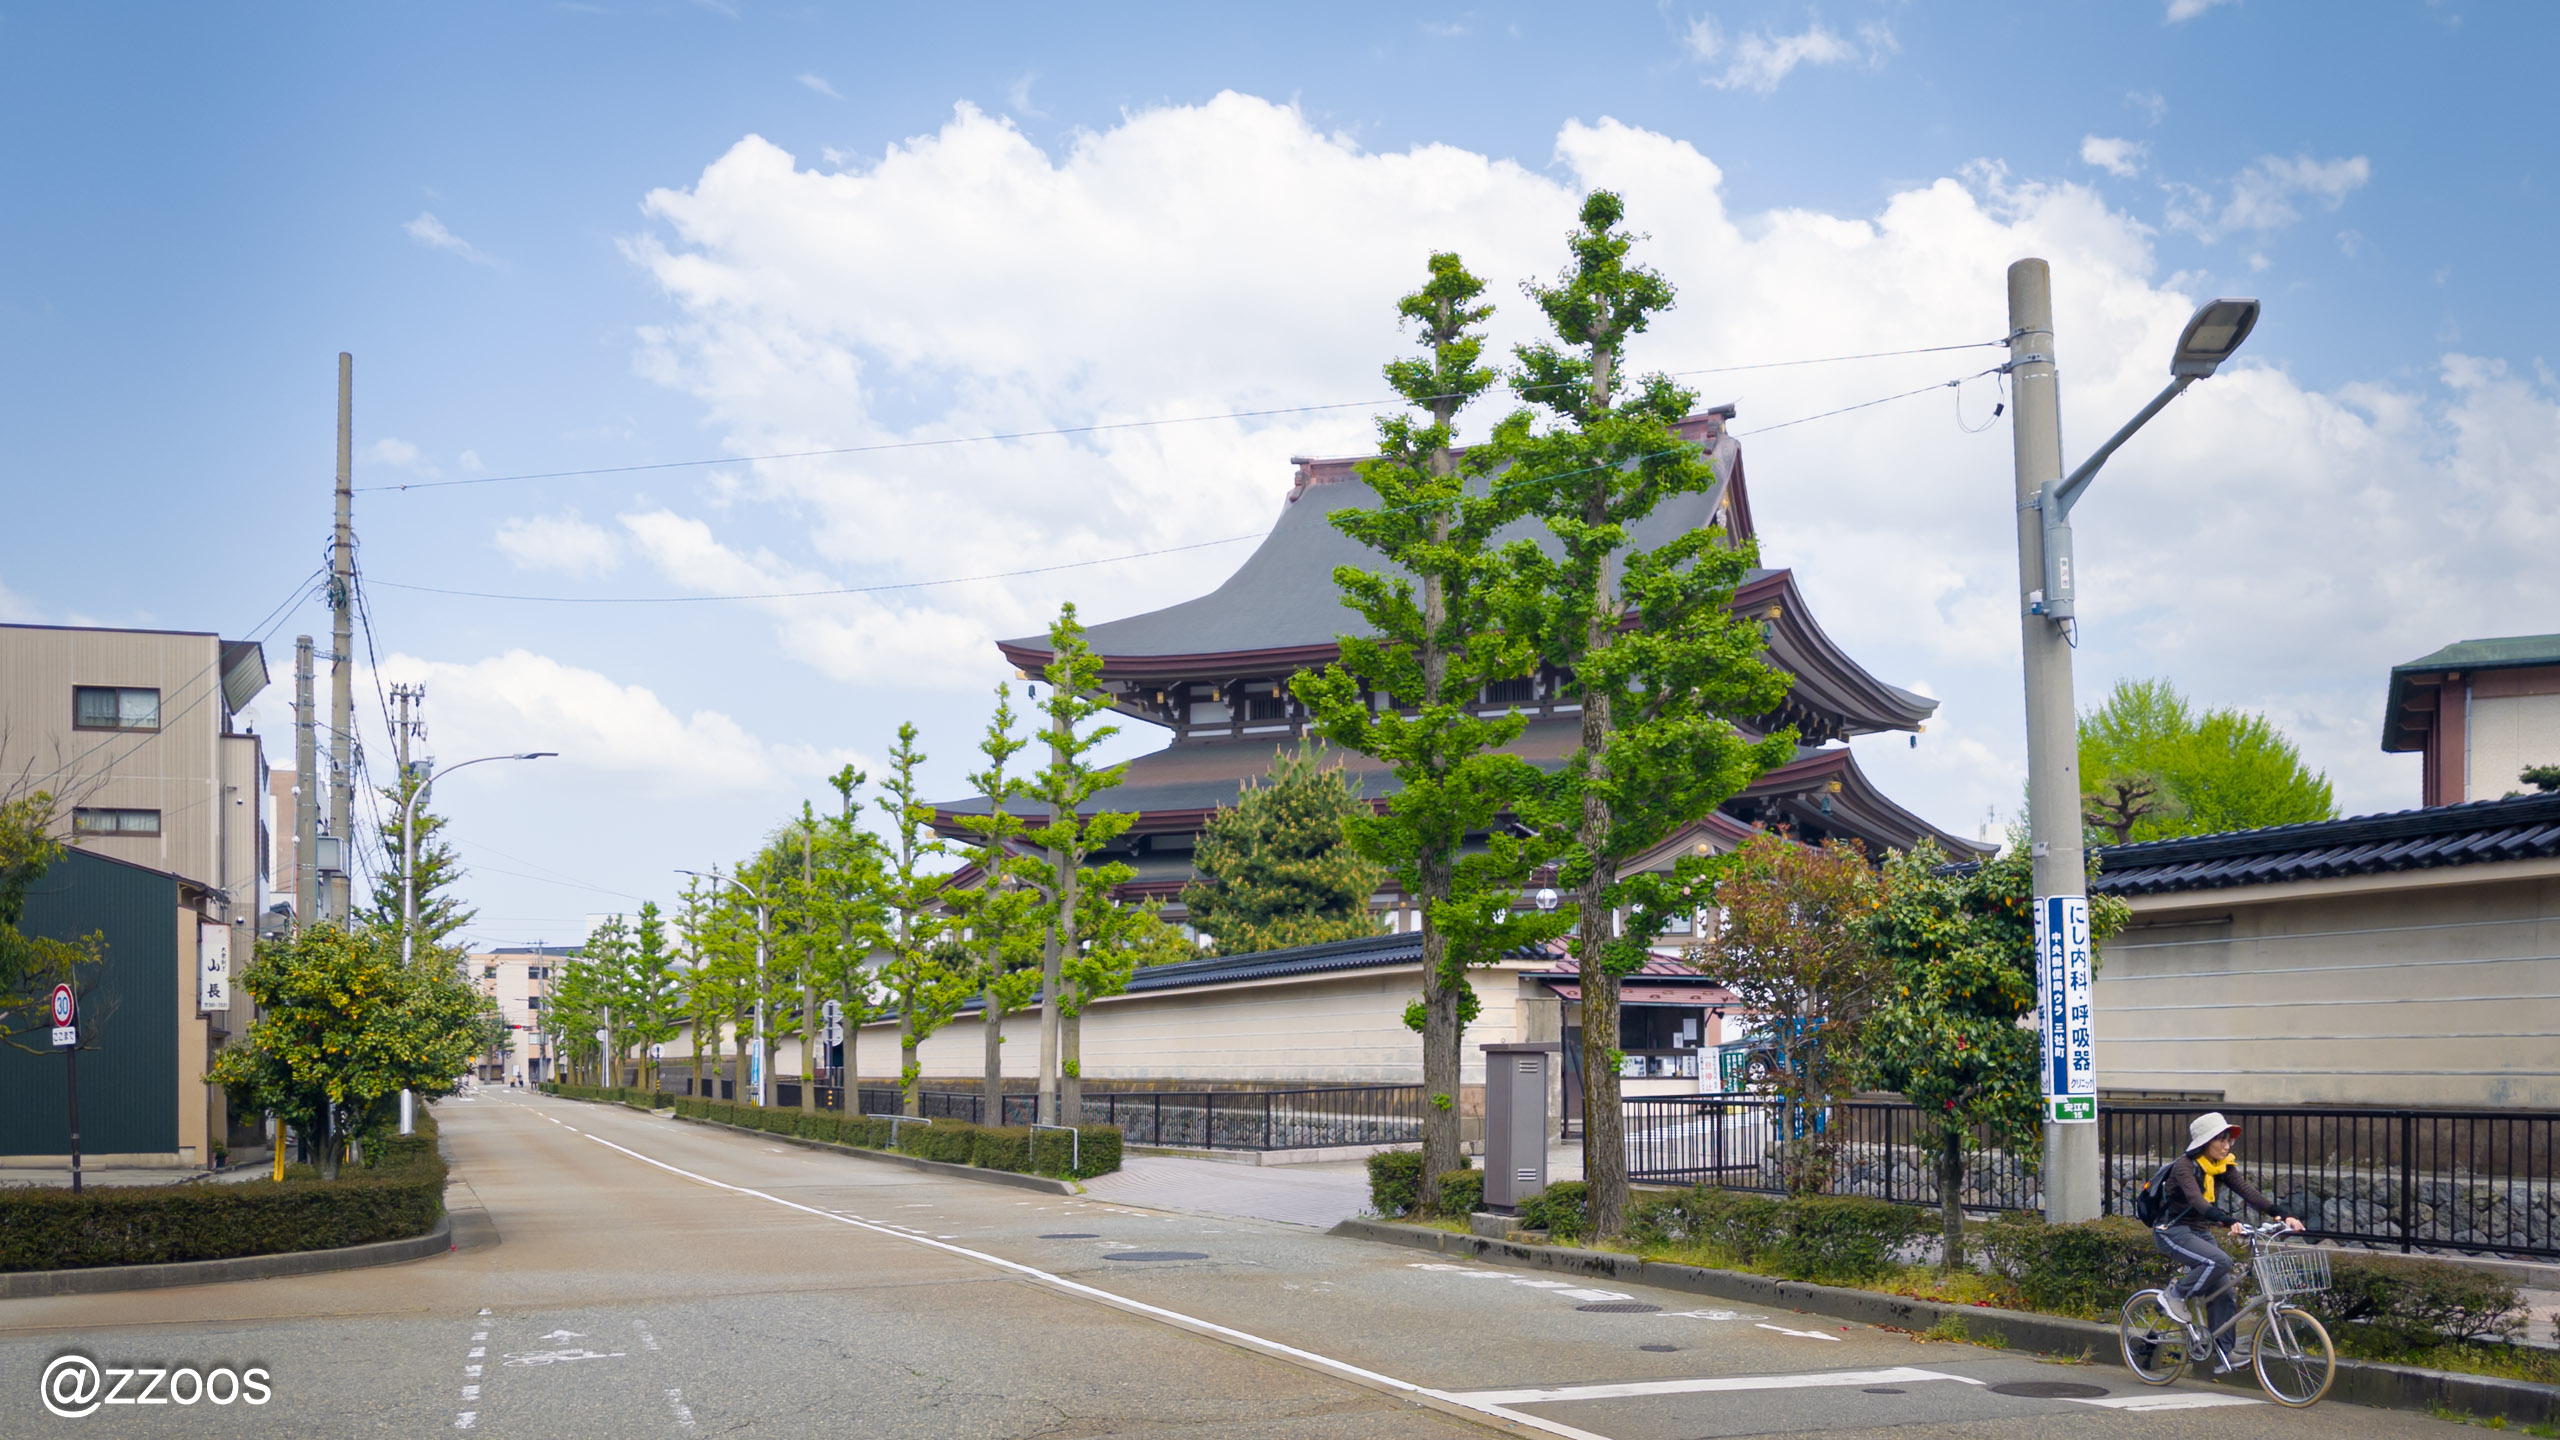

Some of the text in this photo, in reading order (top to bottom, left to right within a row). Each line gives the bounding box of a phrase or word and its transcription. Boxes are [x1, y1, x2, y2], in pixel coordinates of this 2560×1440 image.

[207, 958, 221, 998] 山長
[2070, 905, 2090, 1071] にし内科・呼吸器
[57, 996, 69, 1015] 30
[53, 1031, 74, 1042] ここまで
[2053, 1022, 2065, 1059] 三社町
[2071, 1079, 2093, 1089] クリニック
